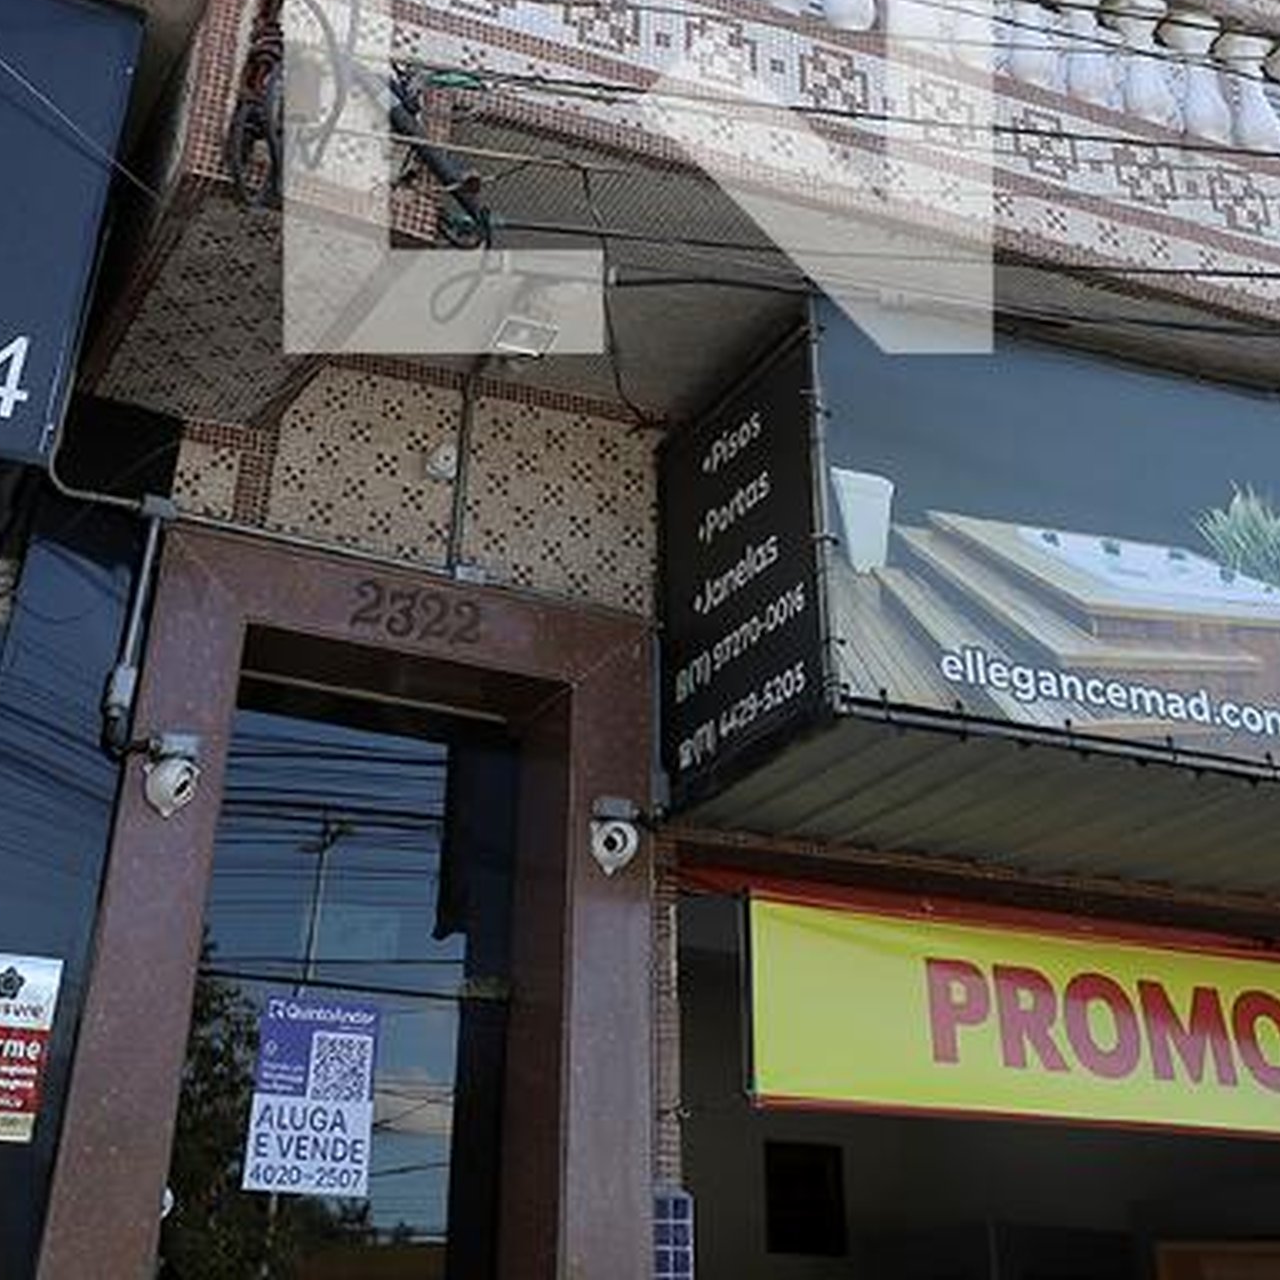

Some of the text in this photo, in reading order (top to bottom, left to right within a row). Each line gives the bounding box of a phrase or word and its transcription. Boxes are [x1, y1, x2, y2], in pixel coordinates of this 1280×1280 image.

[711, 412, 761, 471] Pisos
[705, 471, 770, 544] Portas
[702, 535, 779, 614] Janelas
[348, 579, 481, 645] 2322
[255, 1103, 348, 1134] ALUGA
[249, 1162, 363, 1189] 4020-2507
[254, 1132, 365, 1165] E VENDE
